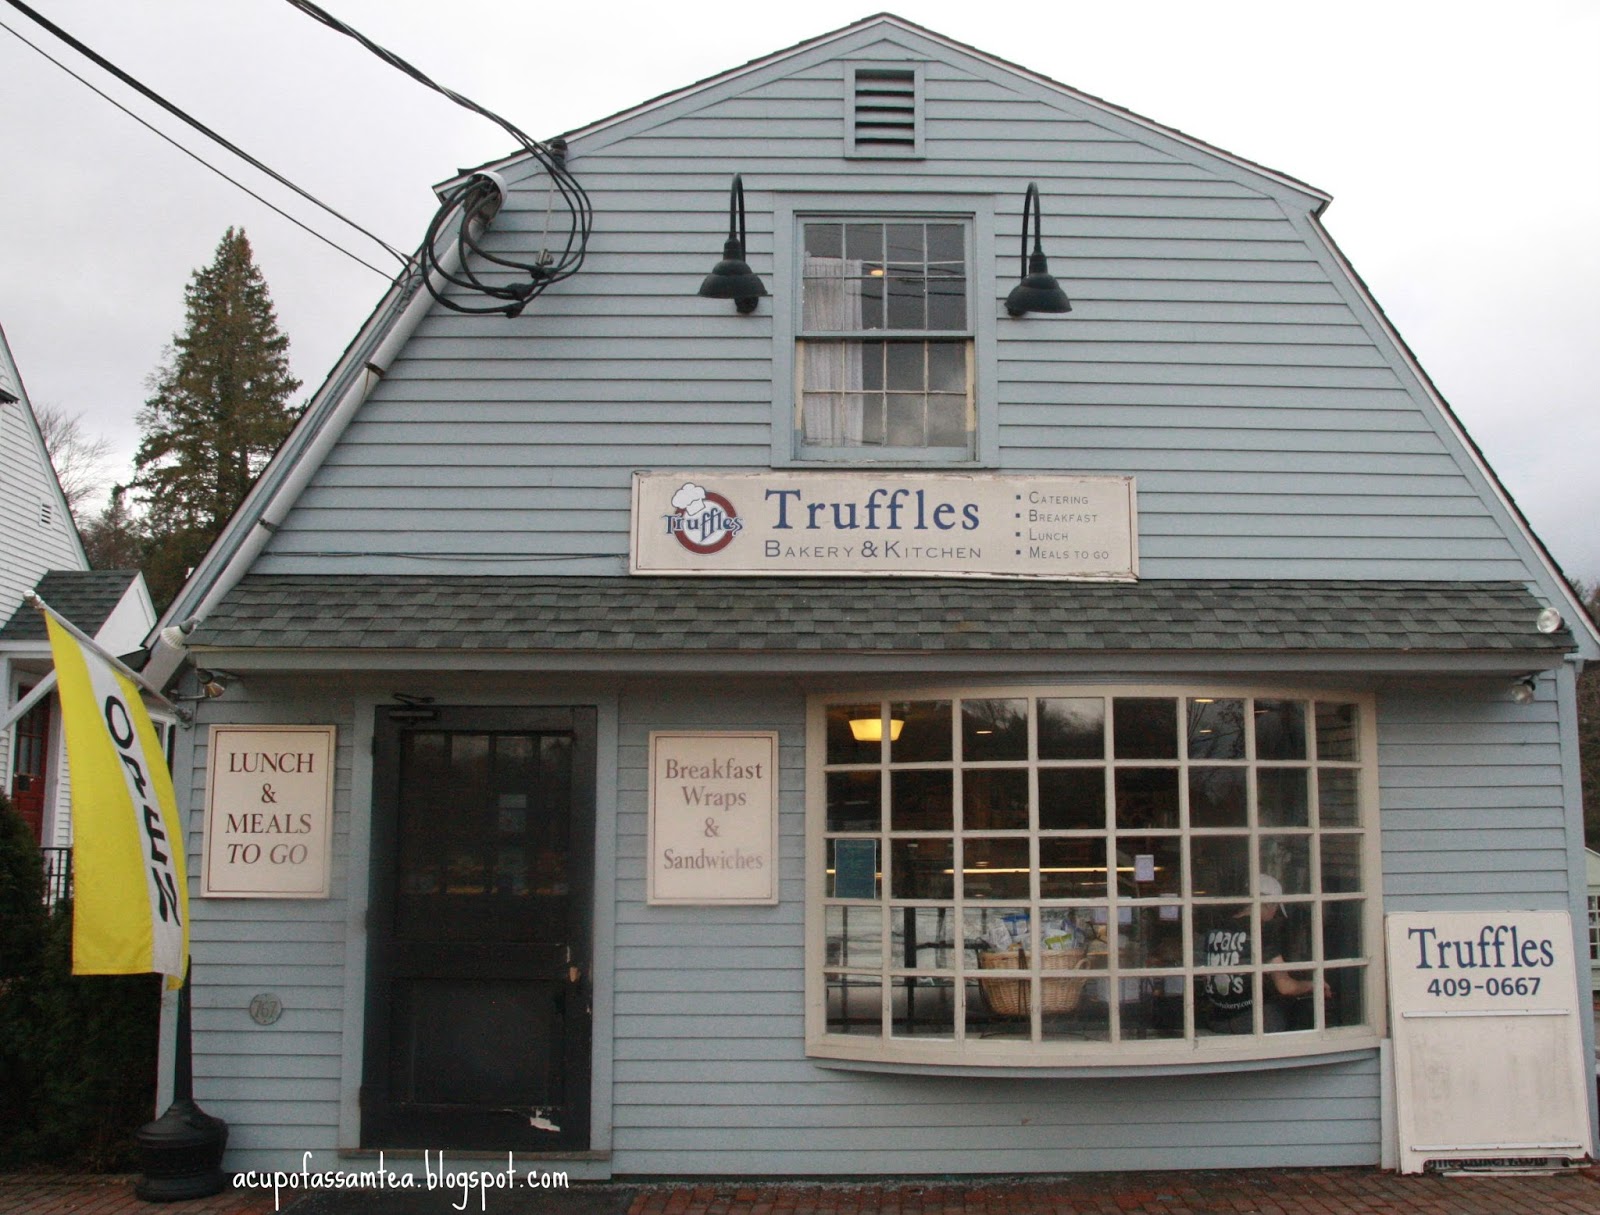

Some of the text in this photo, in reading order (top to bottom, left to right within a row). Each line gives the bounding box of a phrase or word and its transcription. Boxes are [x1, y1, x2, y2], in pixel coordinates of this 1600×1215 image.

[1028, 491, 1089, 505] CATERING
[764, 488, 980, 531] Truffles
[1028, 509, 1098, 523] BREAKFAST
[661, 507, 744, 543] Truffles
[1029, 528, 1069, 541] LUNCH
[764, 539, 854, 558] BAKERY
[884, 540, 981, 559] KITCHEN
[1029, 546, 1109, 560] MEALS TO GO
[229, 752, 314, 773] LUNCH
[665, 757, 763, 780] Breakfast
[261, 783, 278, 804] &
[681, 785, 747, 812] Wraps
[104, 695, 182, 928] OPEN
[225, 813, 312, 834] MEALS
[704, 817, 721, 838] &
[227, 843, 308, 865] TO GO
[663, 848, 763, 870] Sandwiches
[1408, 925, 1554, 969] Truffles
[1427, 977, 1541, 997] 409-0667
